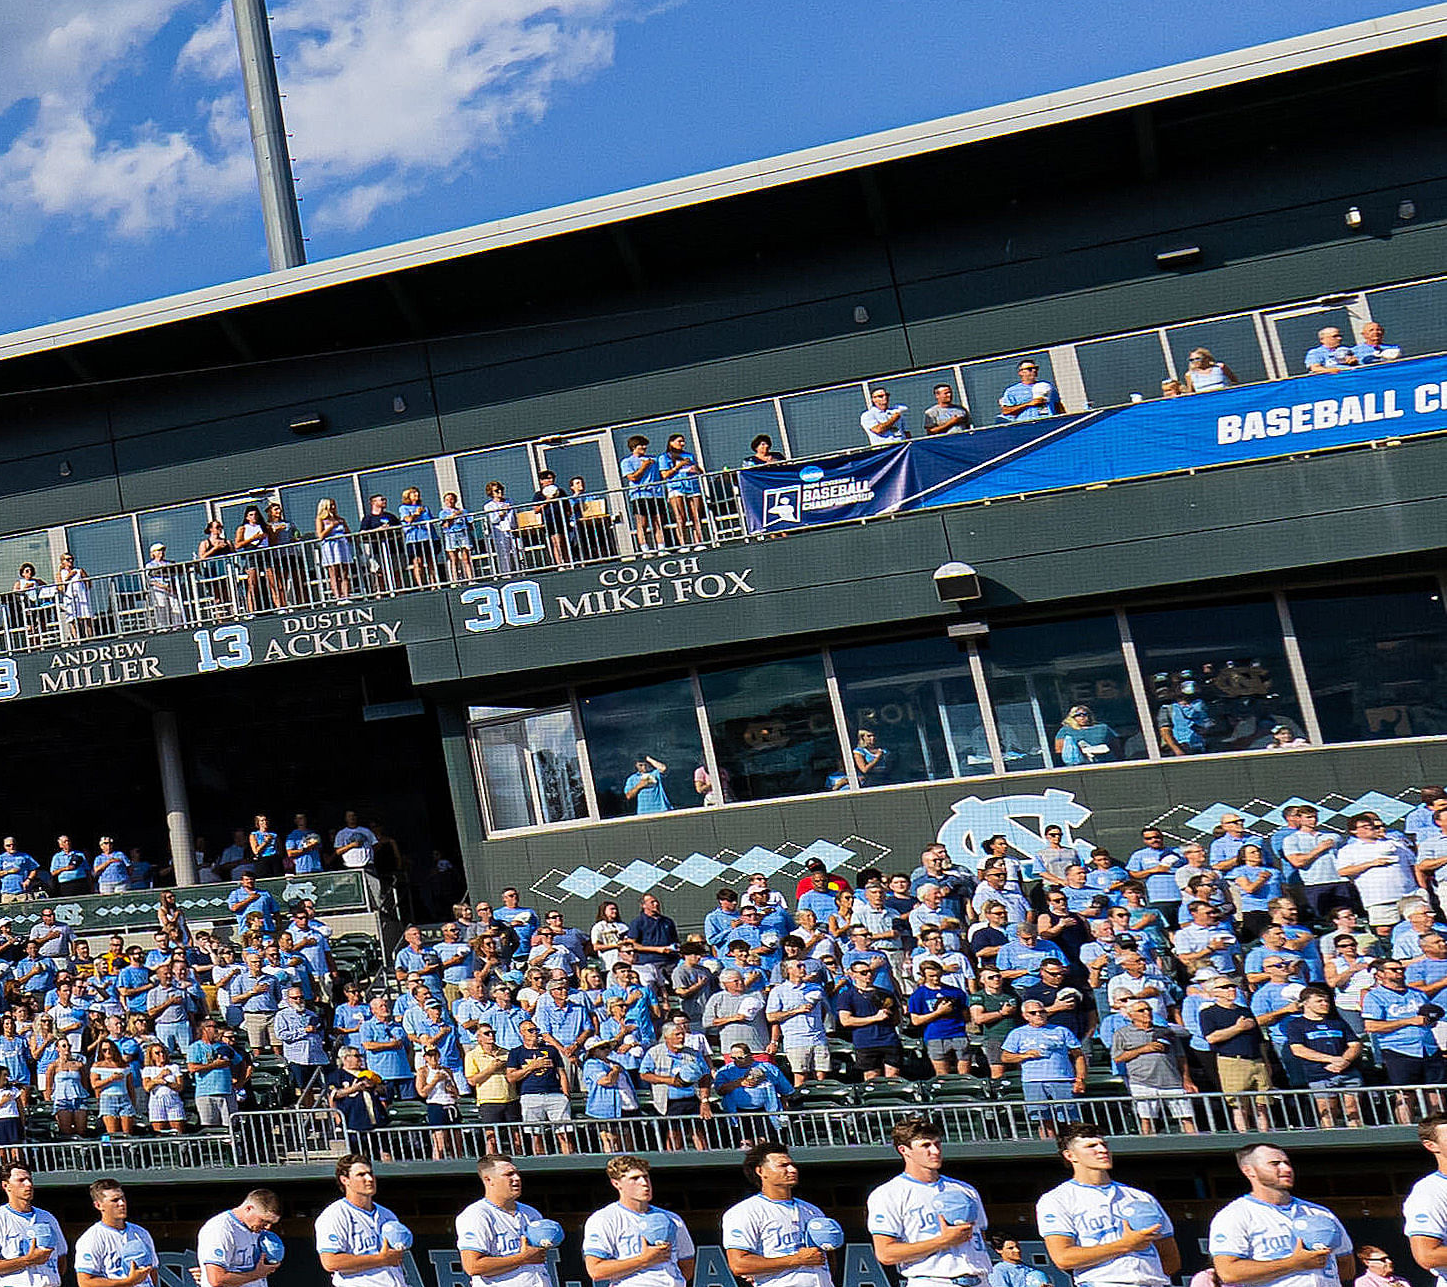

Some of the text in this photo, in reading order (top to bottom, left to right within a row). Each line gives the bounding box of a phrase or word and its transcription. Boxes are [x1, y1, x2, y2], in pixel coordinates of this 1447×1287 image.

[1218, 382, 1447, 445] BASEBALL C
[803, 480, 871, 502] BASEBALL
[599, 557, 701, 586] COACH
[460, 580, 545, 632] 30
[558, 569, 756, 619] MIKE FOX
[282, 606, 374, 635] DUSTIN
[50, 640, 148, 669] ANDREW
[193, 625, 253, 673] 13
[263, 621, 402, 662] ACKLEY
[39, 657, 165, 694] MILLER
[908, 1208, 937, 1229] Ta
